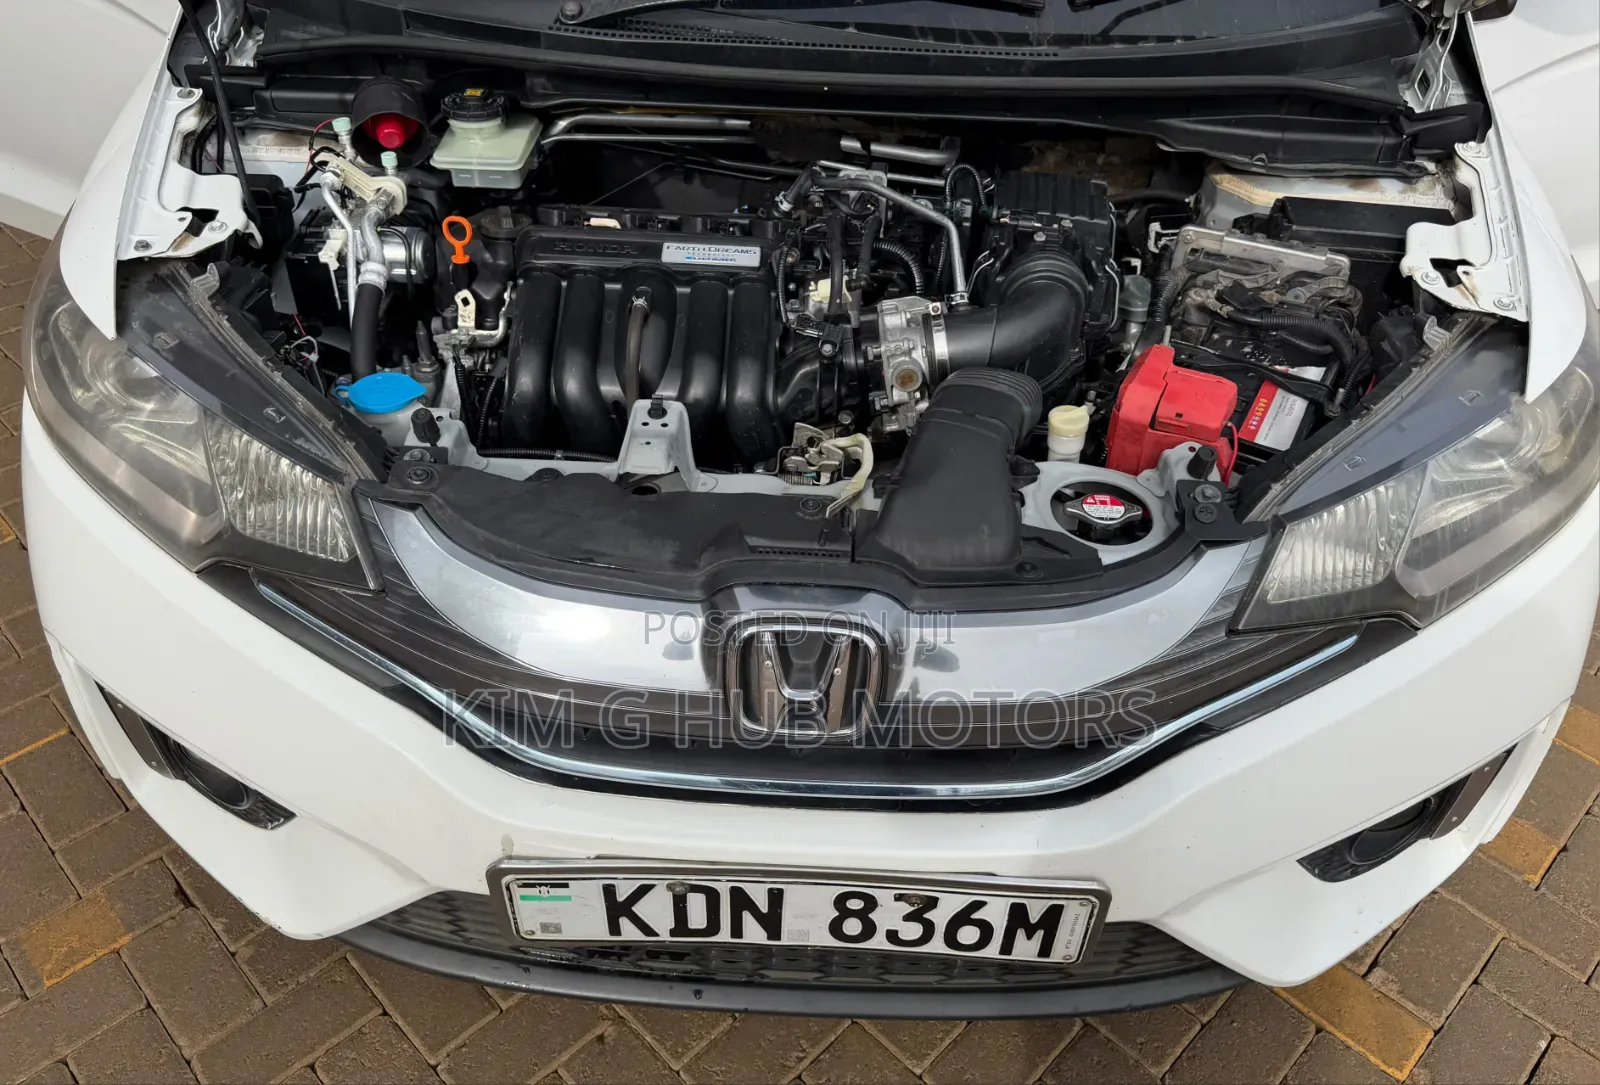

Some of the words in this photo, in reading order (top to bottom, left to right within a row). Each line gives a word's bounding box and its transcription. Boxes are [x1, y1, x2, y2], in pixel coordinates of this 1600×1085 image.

[553, 240, 639, 255] HONDA
[666, 244, 707, 253] EARTH
[708, 246, 757, 255] DREAMS
[602, 882, 784, 942] KDN
[828, 890, 1066, 958] 836M
